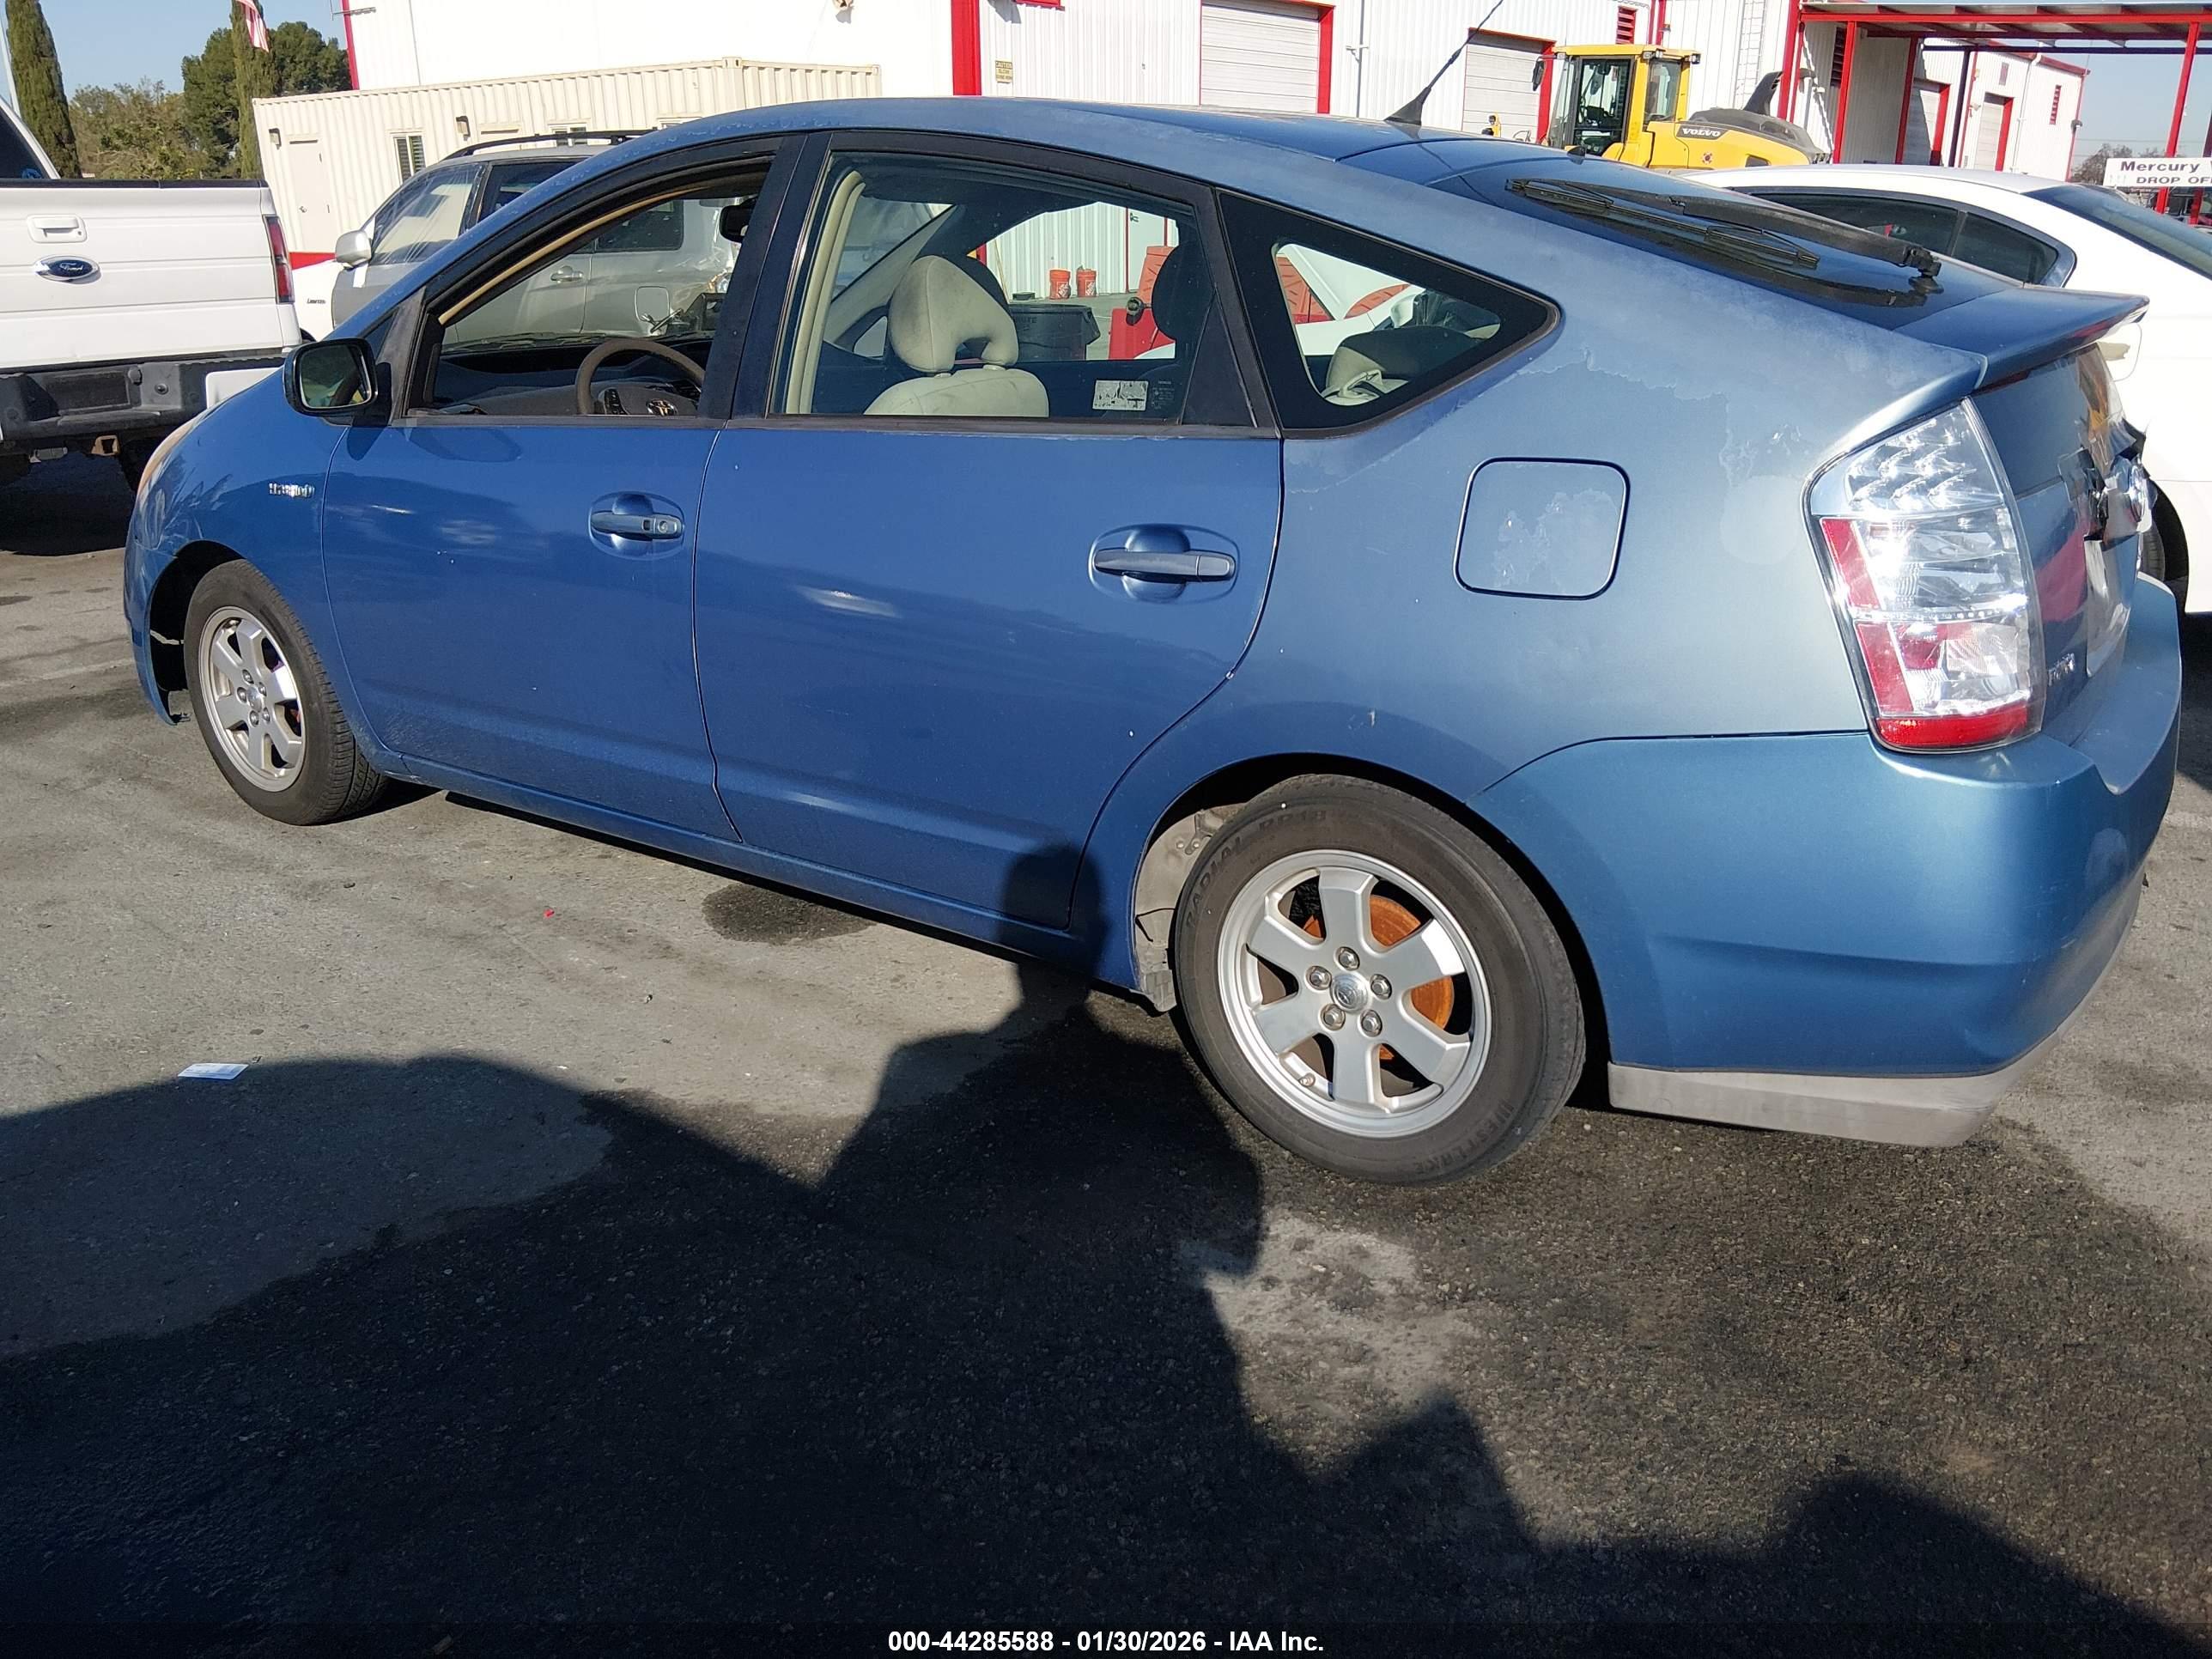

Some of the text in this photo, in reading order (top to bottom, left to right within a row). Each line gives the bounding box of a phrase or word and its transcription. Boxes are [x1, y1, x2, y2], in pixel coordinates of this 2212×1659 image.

[1682, 128, 1721, 137] VOLVO
[2120, 161, 2200, 173] Mercury
[2136, 176, 2181, 185] DROP
